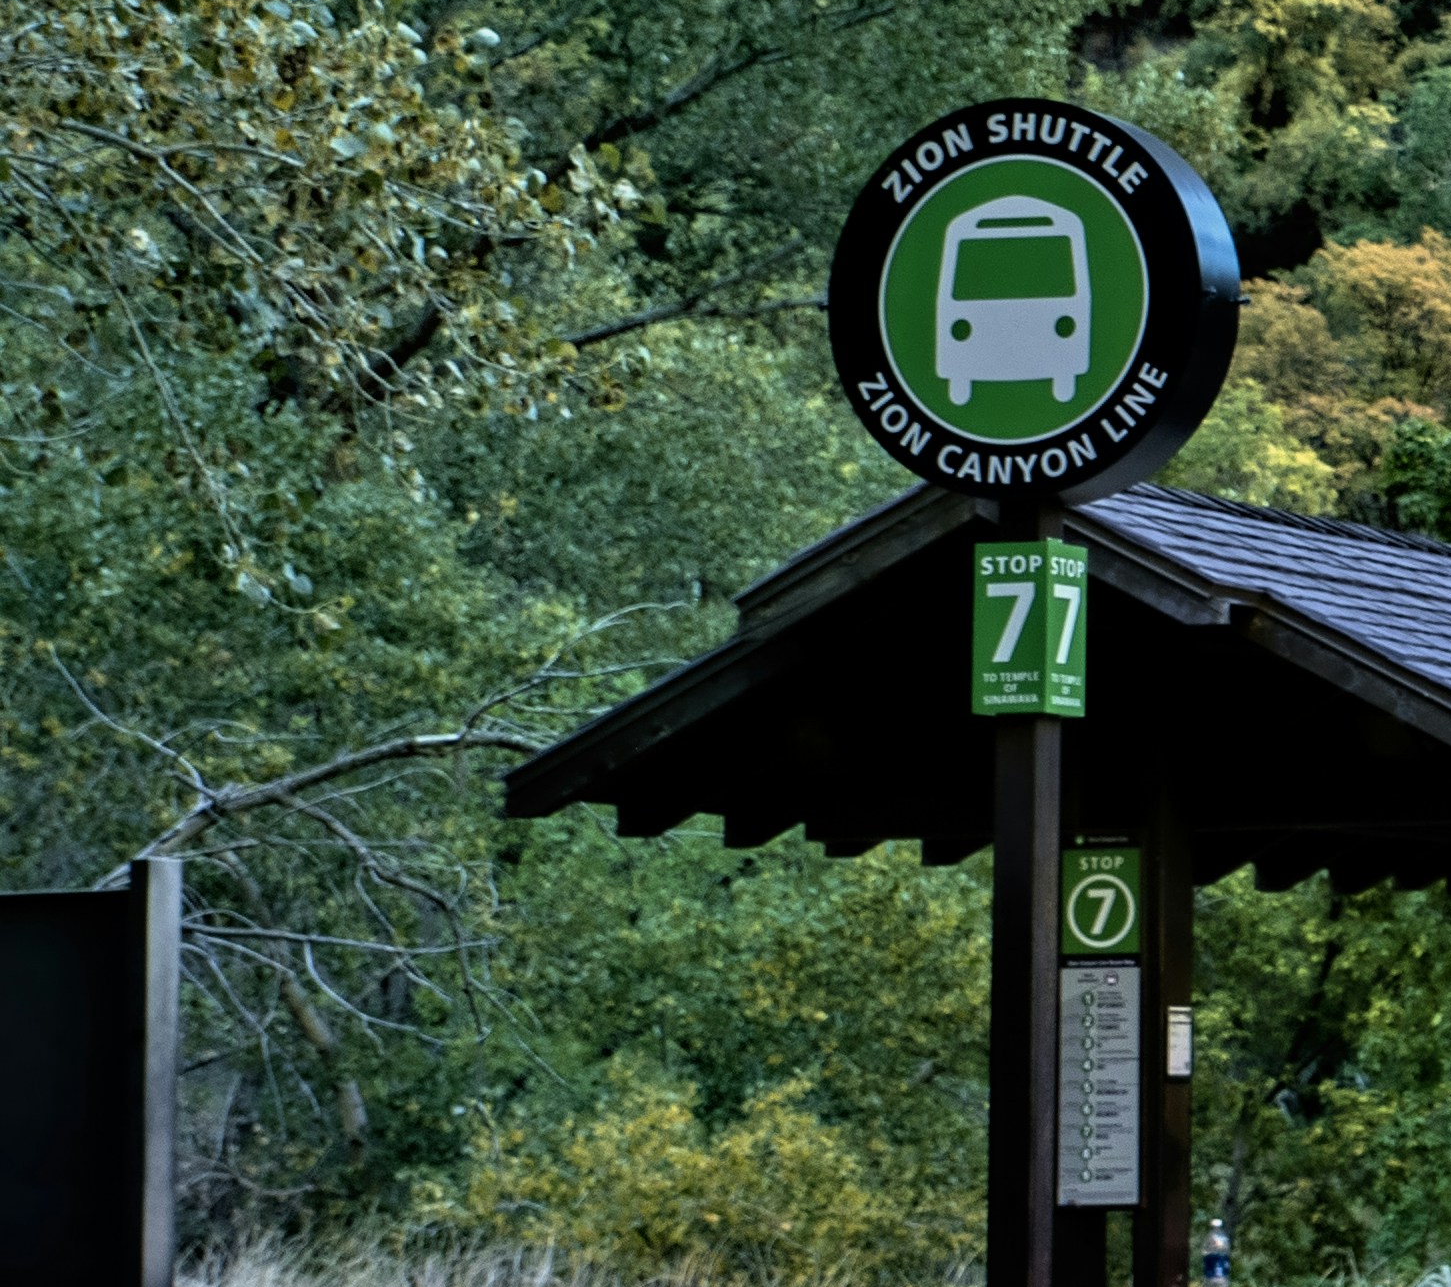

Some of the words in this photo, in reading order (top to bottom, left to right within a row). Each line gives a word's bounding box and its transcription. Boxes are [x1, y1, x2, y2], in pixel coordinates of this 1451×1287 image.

[881, 122, 974, 203] ZION
[986, 112, 1149, 195] SHUTTLE
[857, 372, 932, 456] ZION
[937, 432, 1098, 485] CANYON
[1100, 361, 1169, 444] LINE
[980, 555, 1043, 575] STOP
[1050, 556, 1085, 578] STOP
[986, 581, 1036, 663] 7
[1053, 583, 1081, 664] 7
[1080, 856, 1125, 871] STOP
[1087, 888, 1117, 935] 7
